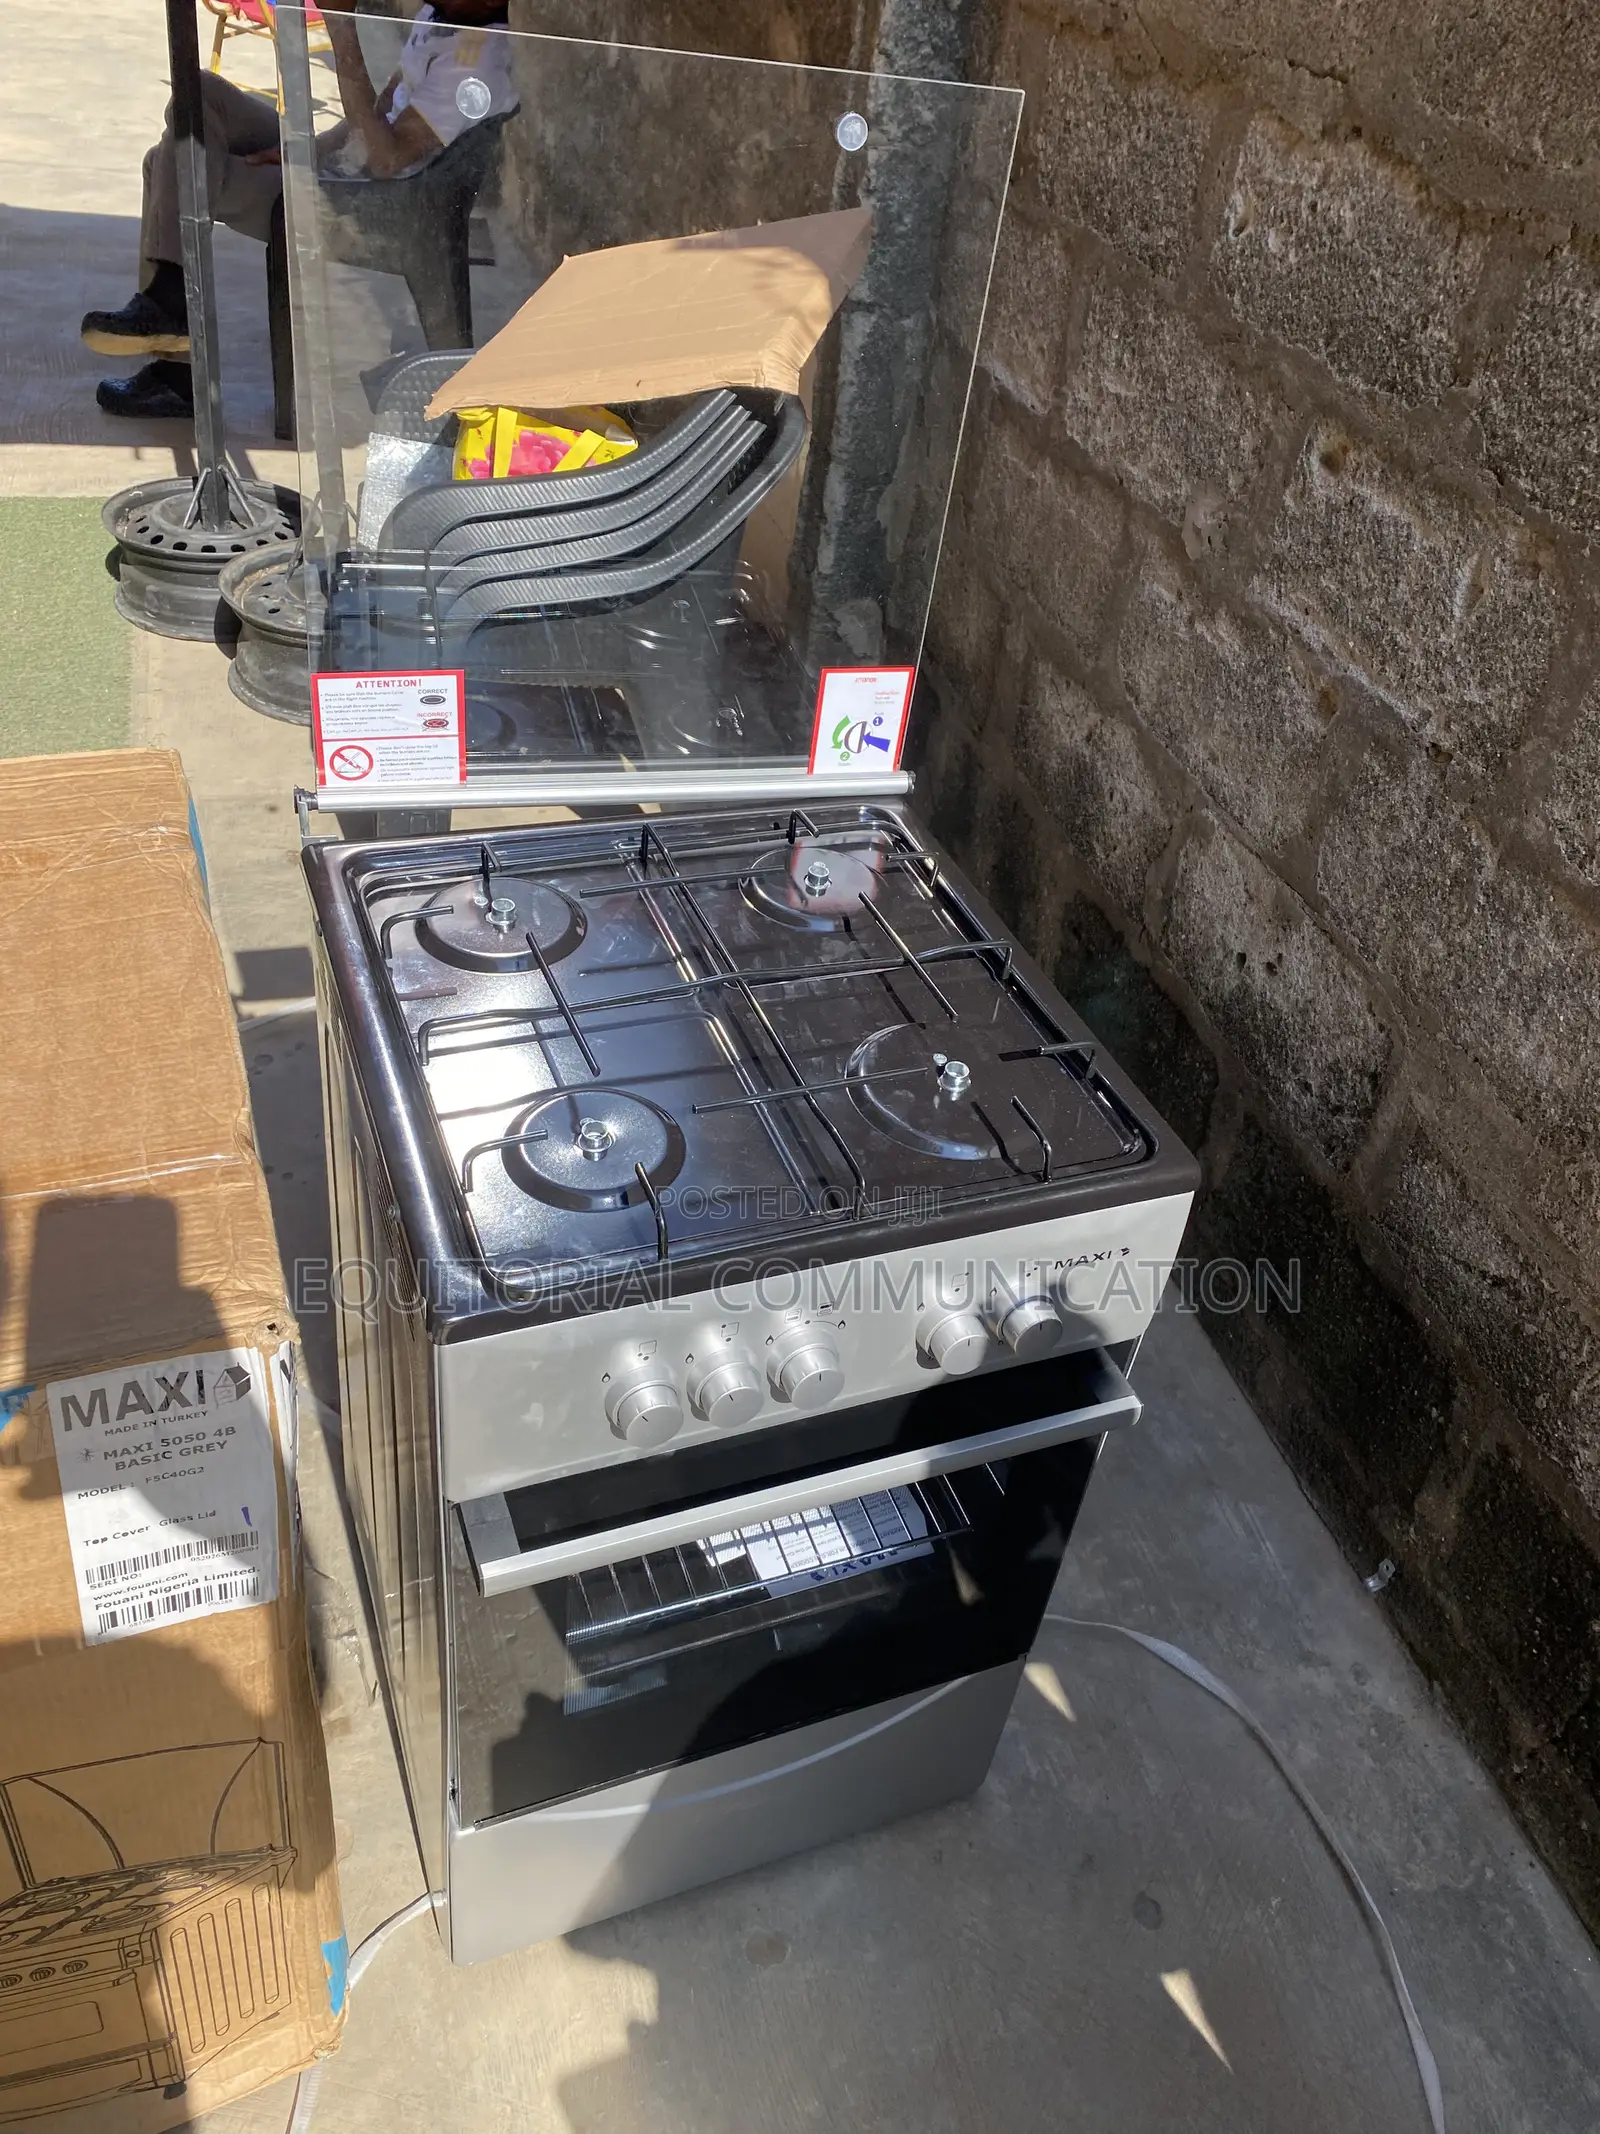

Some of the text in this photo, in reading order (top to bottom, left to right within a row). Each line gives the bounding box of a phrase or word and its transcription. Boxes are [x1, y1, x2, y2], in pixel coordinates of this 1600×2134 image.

[356, 678, 422, 689] ATTENTION!
[1054, 1250, 1112, 1270] MAXI
[60, 1369, 206, 1432] MAXI
[104, 1410, 209, 1436] MADE IN TURKEY
[103, 1426, 237, 1461] MAXI 5050 4B
[115, 1440, 228, 1472] BASIC GREY
[77, 1482, 127, 1500] MODEL
[83, 1509, 217, 1547] Top Cover Glass Lid
[89, 1578, 118, 1590] SERI
[93, 1572, 188, 1601] www.fouani.com
[95, 1566, 261, 1611] Fouani Nigeria Limited.
